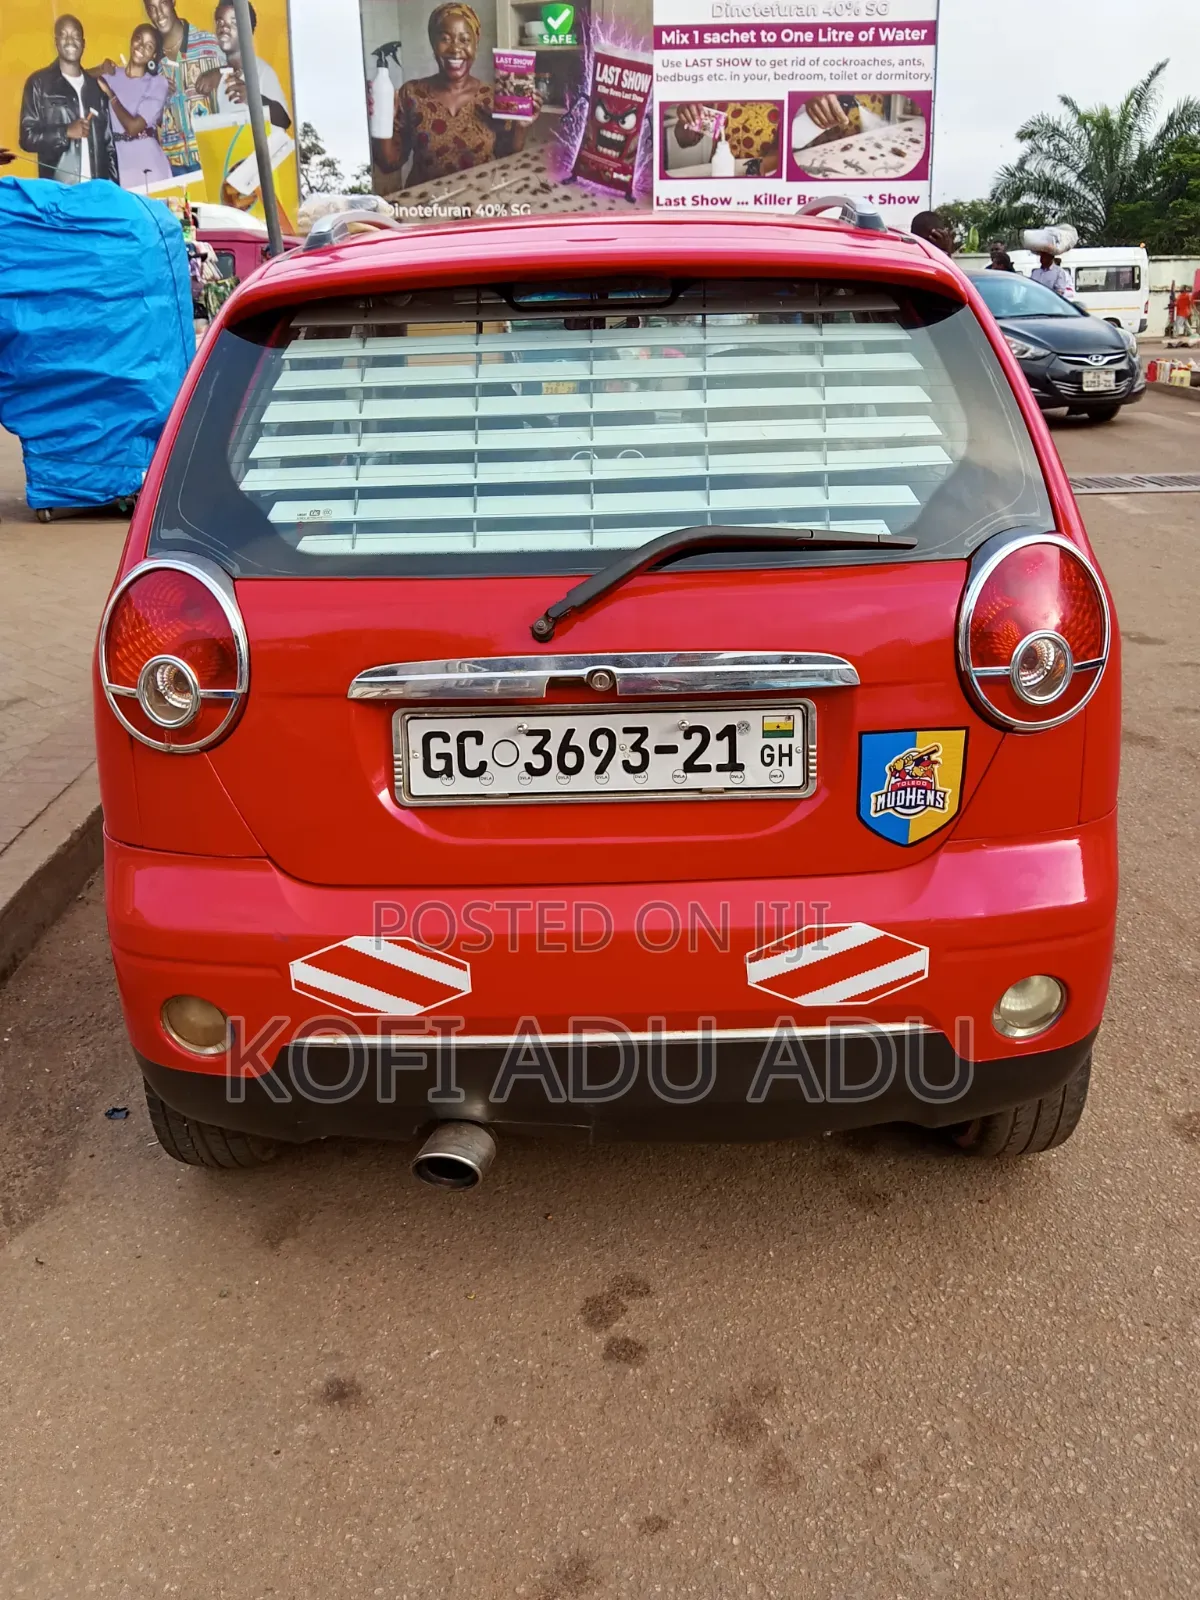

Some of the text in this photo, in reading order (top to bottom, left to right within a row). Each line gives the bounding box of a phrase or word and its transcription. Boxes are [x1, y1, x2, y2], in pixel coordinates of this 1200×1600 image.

[711, 0, 890, 18] Dinotefuran 40% SG
[542, 34, 573, 44] SAFE
[661, 26, 928, 45] Mix 1 sachet to One Litre of Water
[495, 56, 534, 66] LAST SHOW
[661, 56, 925, 69] Use LAST SHOW to get rid of cockroaches, ants,
[595, 62, 622, 86] LAST
[621, 69, 652, 93] SHOW
[656, 70, 933, 84] bedbugs etc. in your, bedroom, toilet or dormitory.
[655, 195, 687, 207] Last
[691, 194, 732, 207] Show
[754, 192, 793, 206] Killer
[878, 193, 920, 205] Show
[475, 203, 507, 217] 40%
[510, 203, 531, 216] SG
[421, 724, 745, 778] GC 3693-21
[760, 743, 793, 768] GH
[876, 787, 945, 812] MUDHENS
